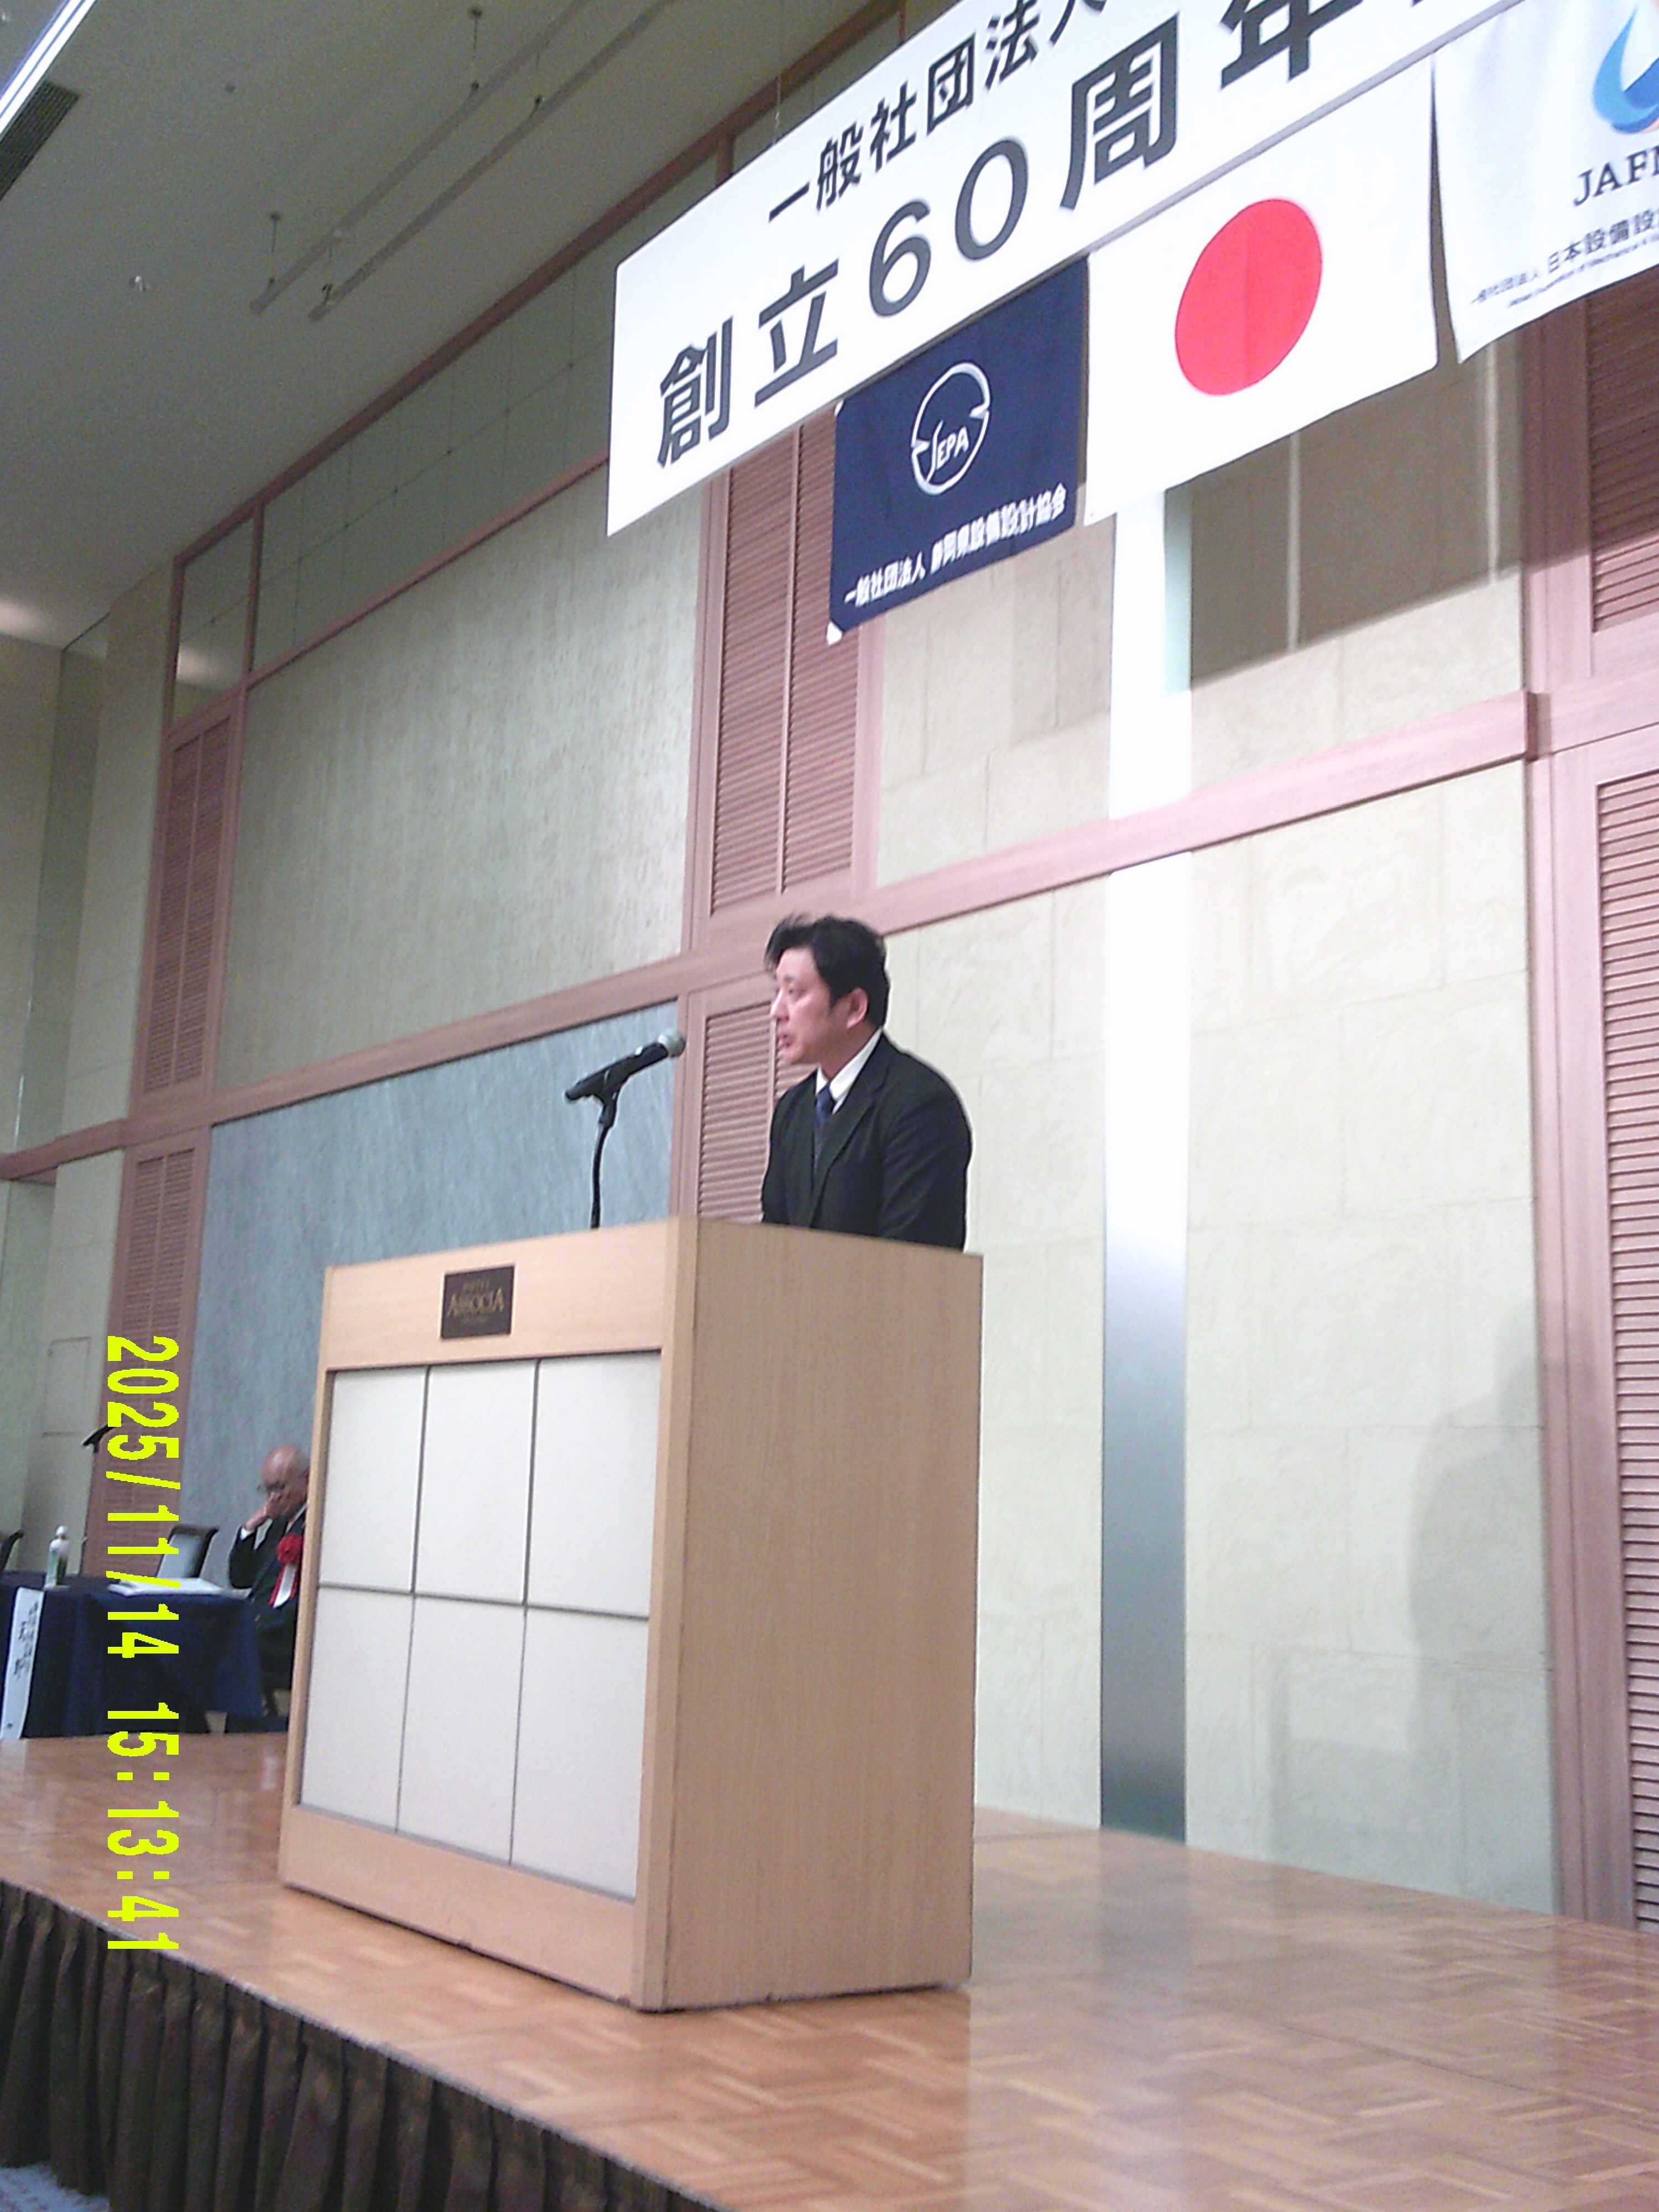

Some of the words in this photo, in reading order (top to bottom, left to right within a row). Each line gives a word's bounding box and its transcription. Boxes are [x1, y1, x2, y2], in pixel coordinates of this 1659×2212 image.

[658, 0, 1423, 469] 創立60周年
[1548, 207, 1659, 274] 日本設備設
